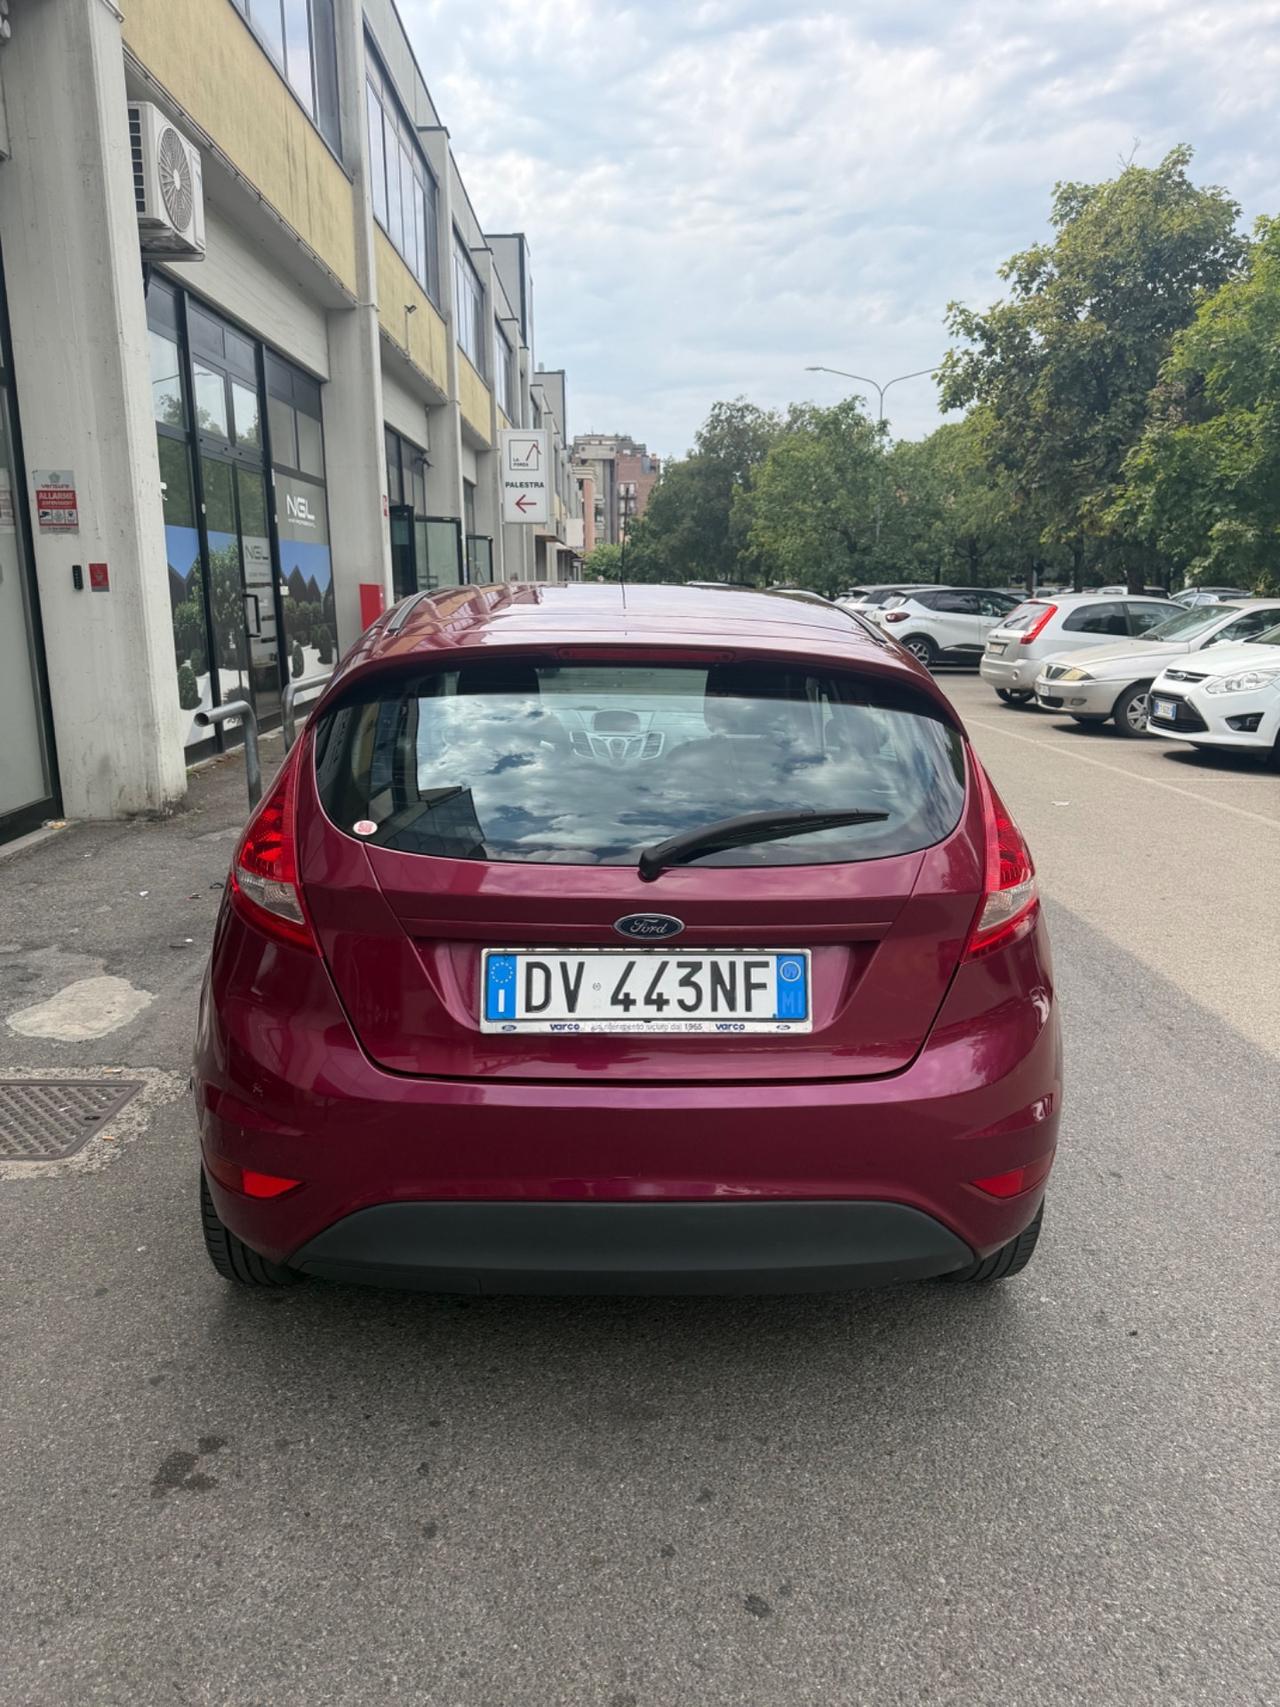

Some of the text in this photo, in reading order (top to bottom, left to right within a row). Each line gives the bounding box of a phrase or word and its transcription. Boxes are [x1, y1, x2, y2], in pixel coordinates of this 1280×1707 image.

[505, 481, 545, 489] PALESTRA
[286, 493, 315, 521] NGL
[630, 918, 668, 934] Ford
[525, 961, 770, 1013] DV 443NF
[549, 1023, 580, 1031] varco
[715, 1023, 746, 1031] varco
